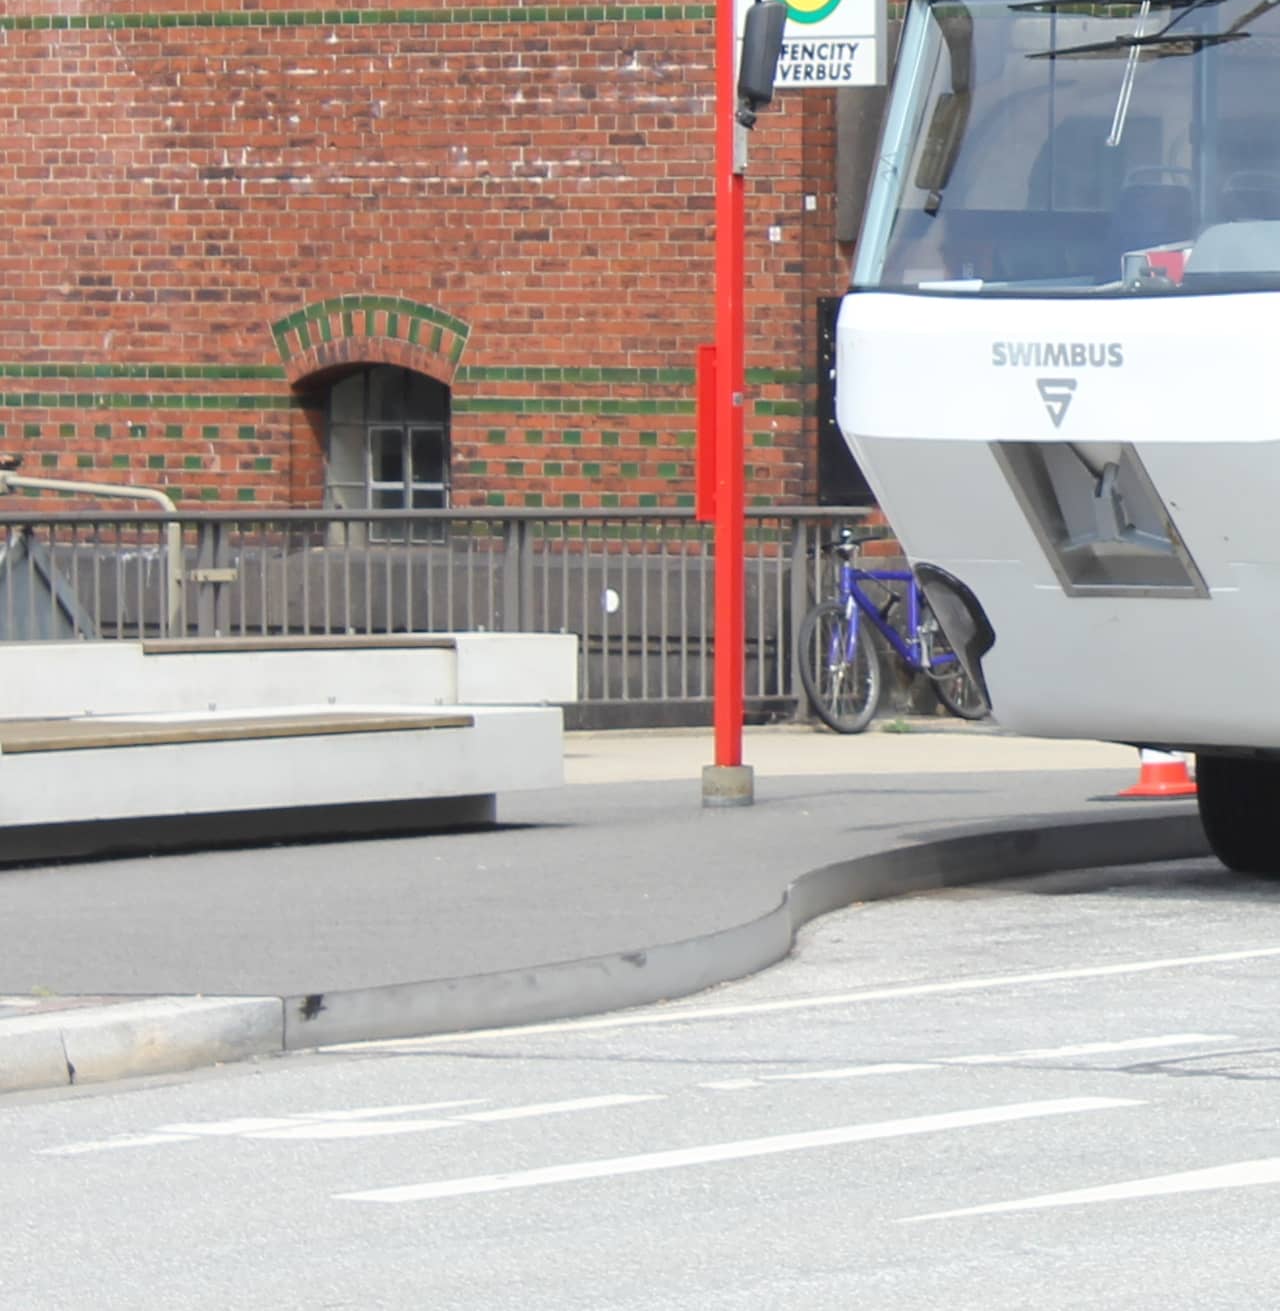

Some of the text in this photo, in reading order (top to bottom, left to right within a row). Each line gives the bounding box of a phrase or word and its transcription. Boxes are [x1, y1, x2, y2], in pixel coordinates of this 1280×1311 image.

[780, 43, 859, 60] FENCITY
[780, 62, 853, 81] VERBUS
[992, 342, 1123, 368] SWIMBUS
